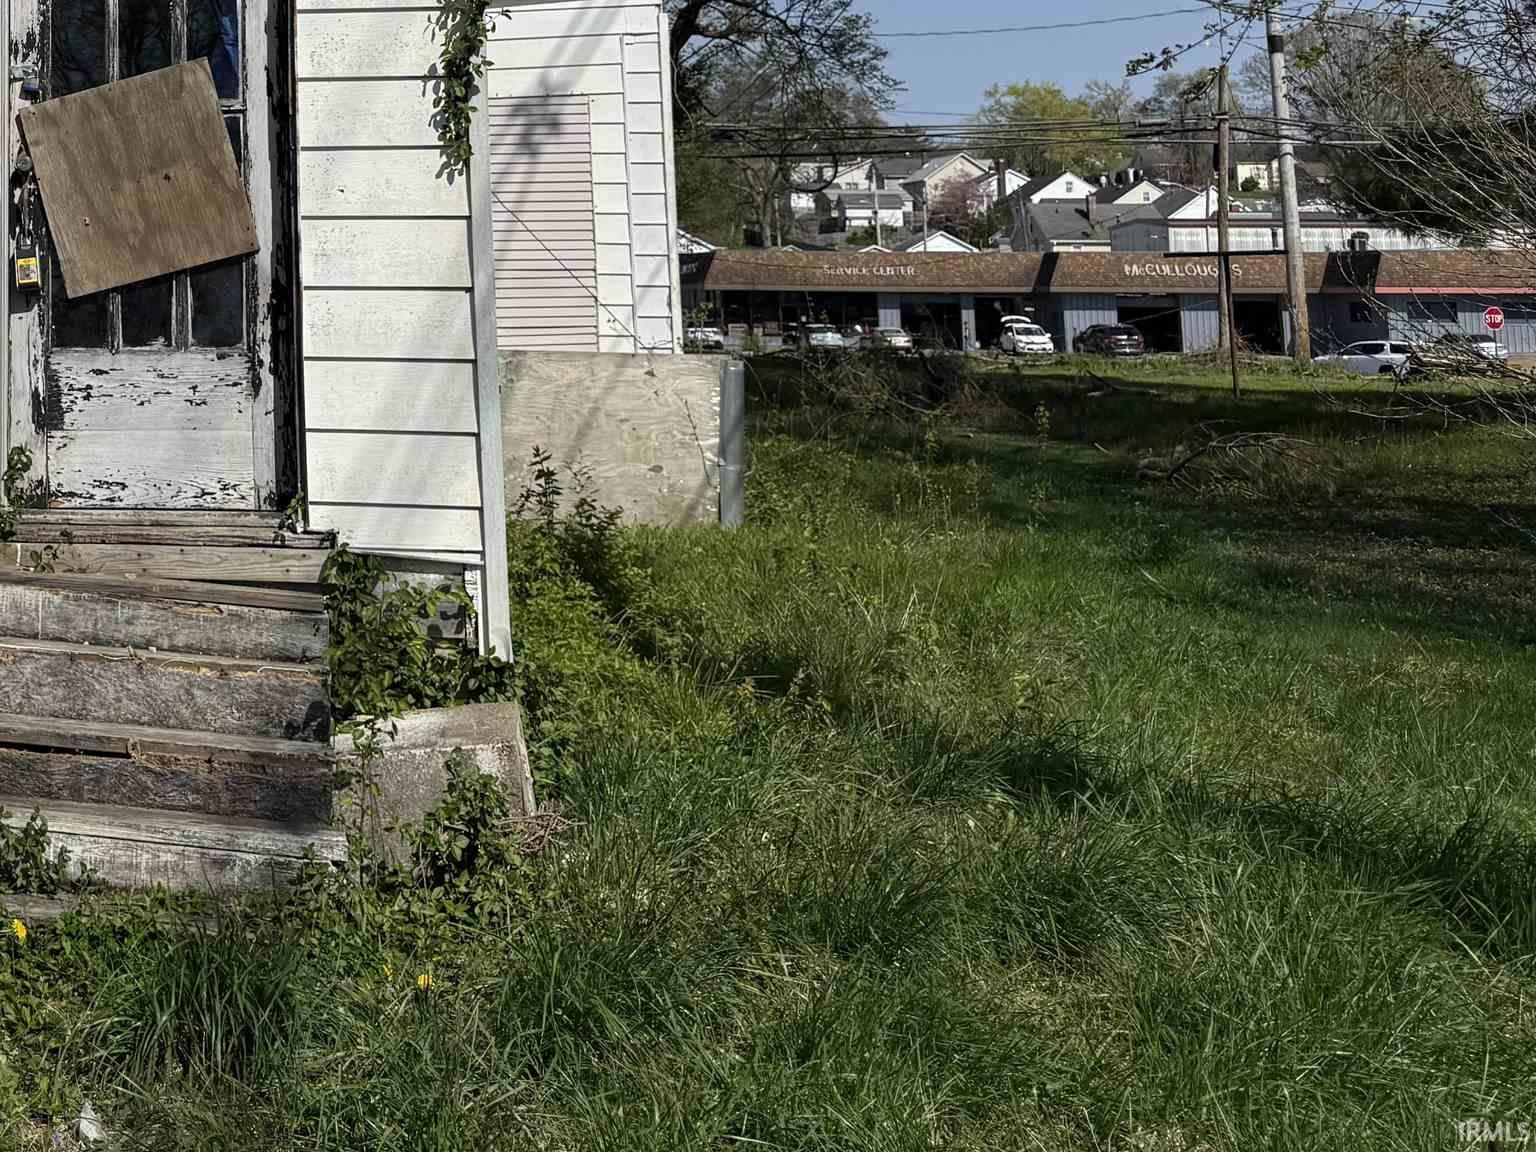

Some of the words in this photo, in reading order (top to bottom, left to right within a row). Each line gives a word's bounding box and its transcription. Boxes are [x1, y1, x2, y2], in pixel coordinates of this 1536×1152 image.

[823, 264, 870, 276] SERVICE
[873, 266, 916, 276] CENTER
[1124, 263, 1242, 278] McCULLOUGS
[1485, 314, 1503, 323] STOP
